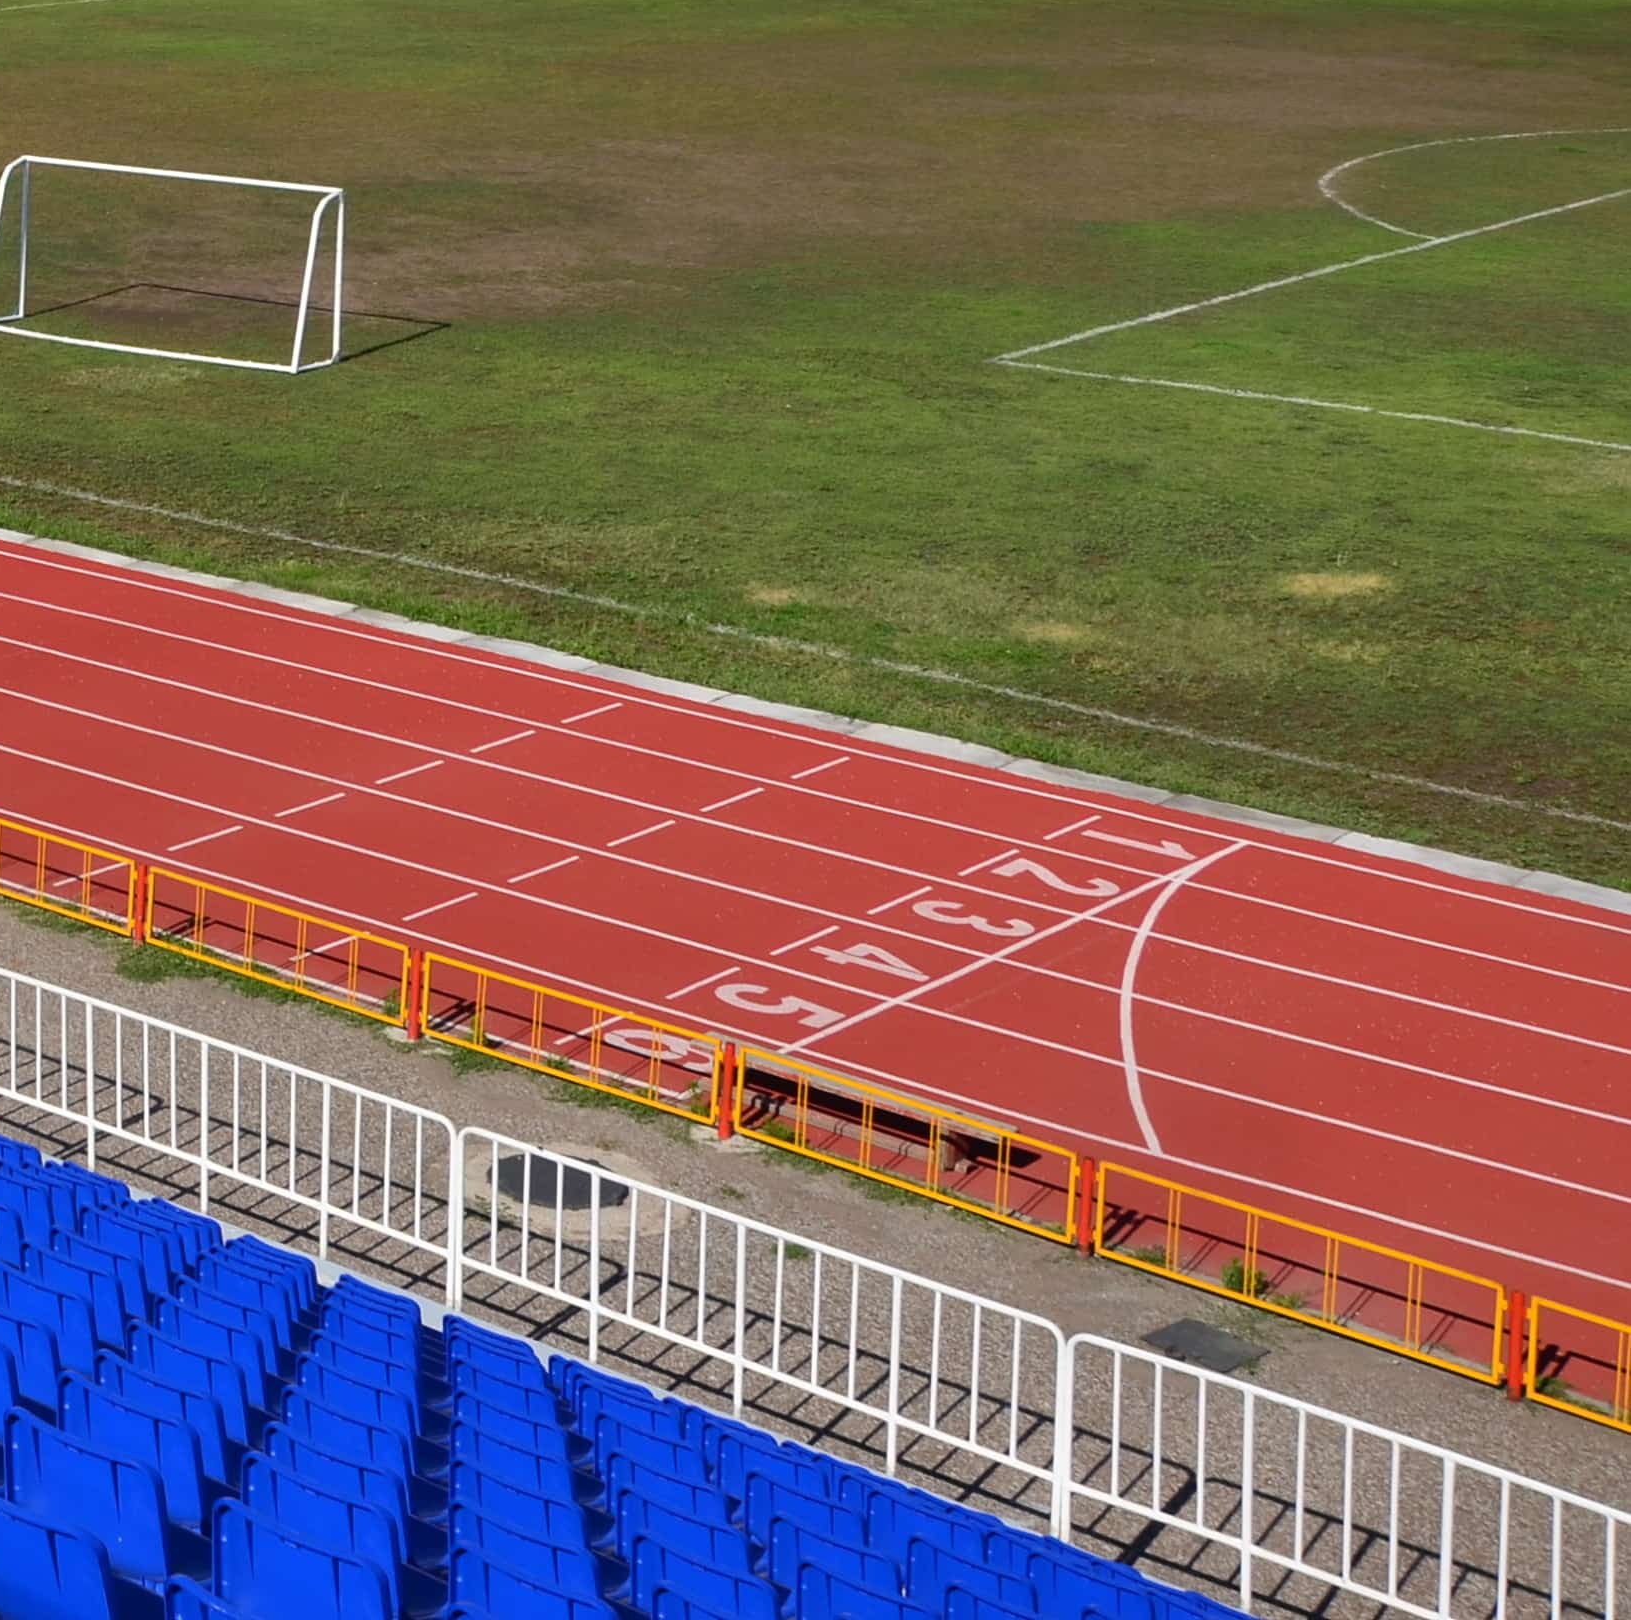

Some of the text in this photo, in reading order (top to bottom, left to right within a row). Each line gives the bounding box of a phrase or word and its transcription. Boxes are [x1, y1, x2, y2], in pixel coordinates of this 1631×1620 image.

[1080, 829, 1198, 861] 1
[990, 858, 1120, 897] 2
[912, 900, 1035, 936] 3
[810, 943, 930, 981] 4
[715, 983, 846, 1029] 5
